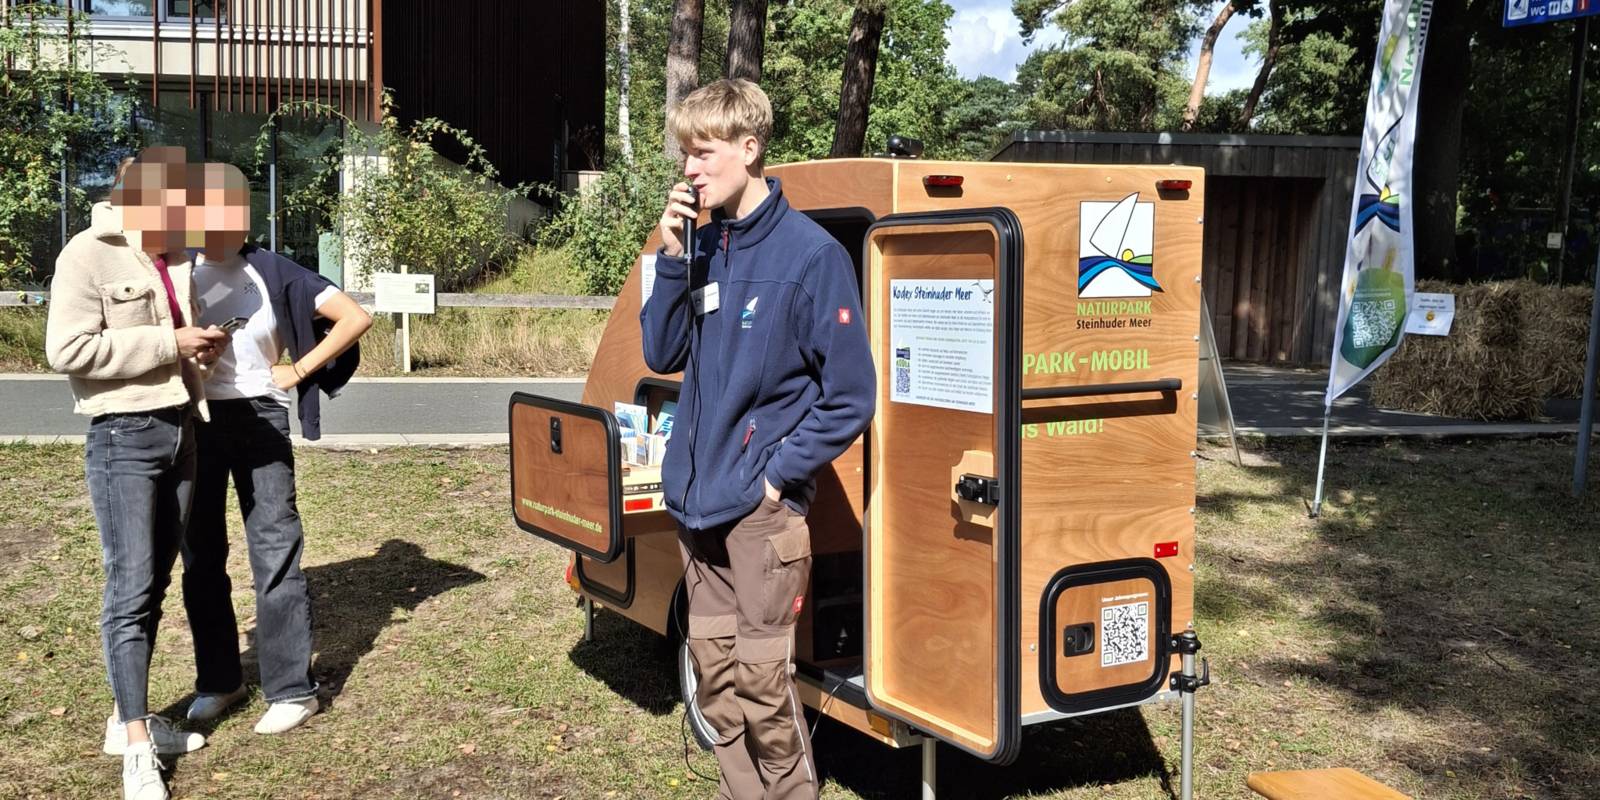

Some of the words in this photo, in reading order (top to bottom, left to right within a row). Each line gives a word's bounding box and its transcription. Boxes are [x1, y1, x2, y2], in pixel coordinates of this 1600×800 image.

[1530, 6, 1546, 16] WC
[914, 286, 953, 301] Steinhuder
[955, 287, 973, 300] Meer
[1076, 300, 1153, 316] NATURPARK
[1076, 317, 1127, 329] Steinhuder
[1129, 318, 1152, 328] Meer
[521, 498, 603, 533] www.naturpark-steinhuder-meer.de
